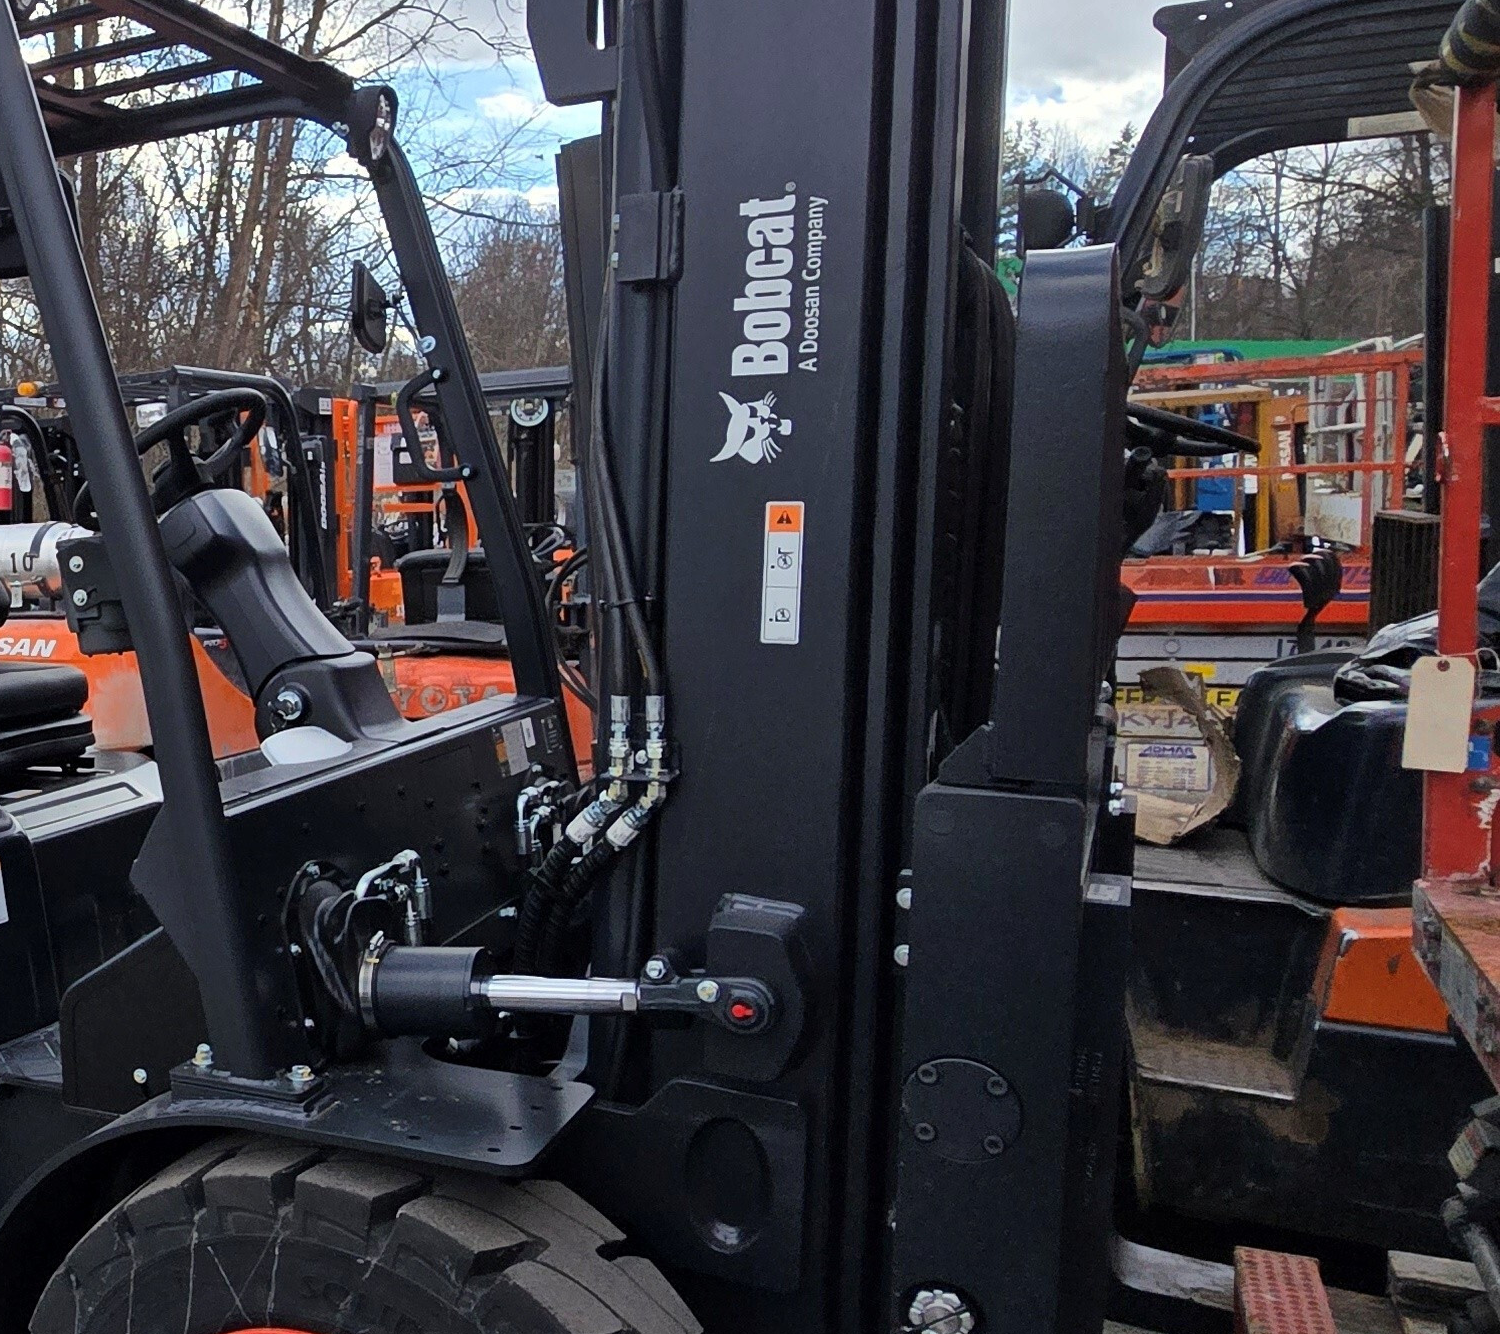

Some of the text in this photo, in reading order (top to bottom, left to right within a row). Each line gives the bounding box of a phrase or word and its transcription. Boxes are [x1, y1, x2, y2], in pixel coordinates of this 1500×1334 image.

[731, 193, 796, 377] Bobcat
[798, 195, 829, 372] A Doosan Company
[10, 552, 34, 574] 10
